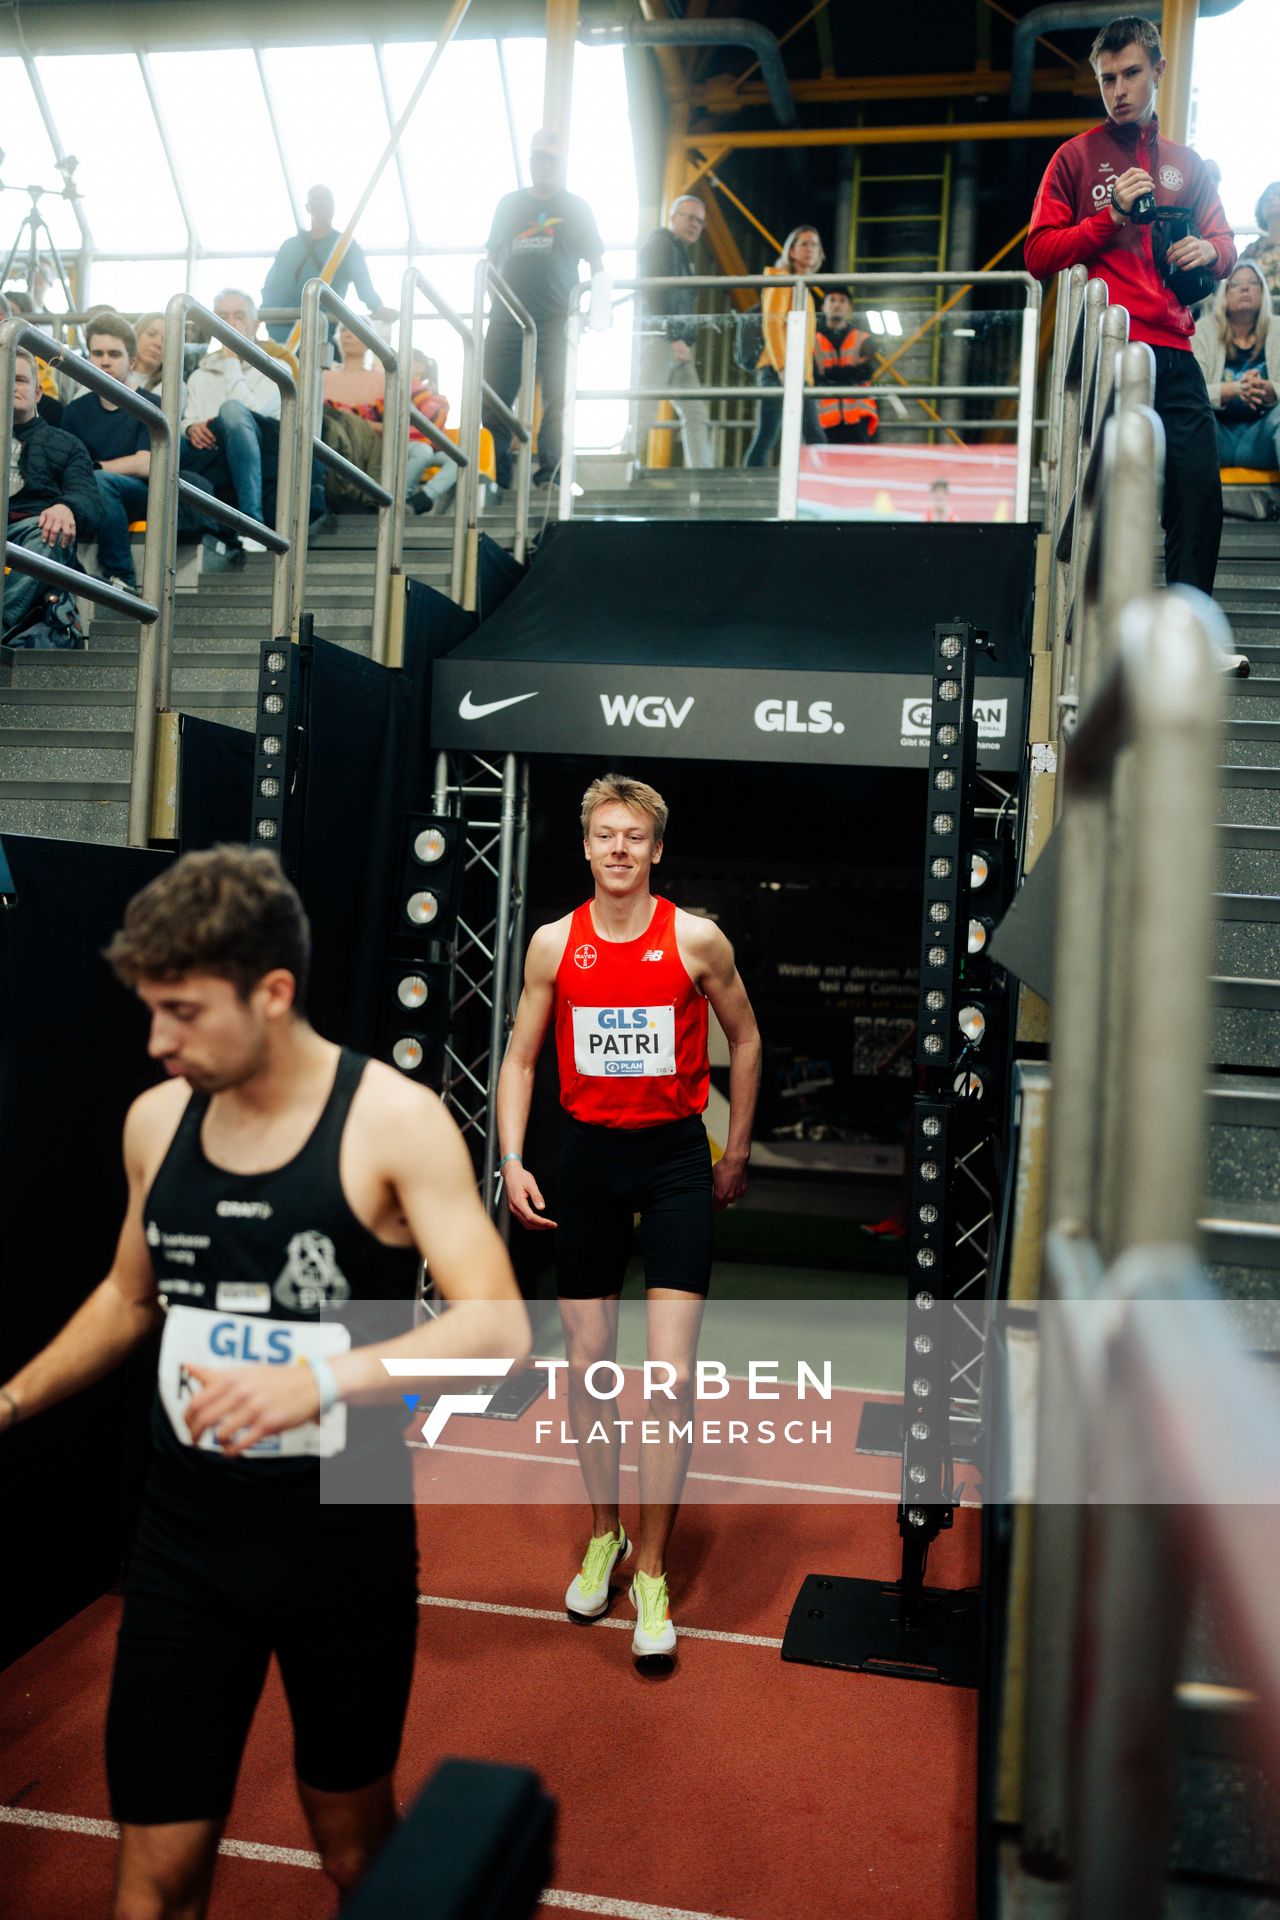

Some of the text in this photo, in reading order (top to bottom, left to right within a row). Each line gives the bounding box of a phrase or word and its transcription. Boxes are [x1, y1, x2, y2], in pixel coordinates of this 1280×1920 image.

[599, 694, 695, 728] WGV
[973, 708, 1001, 722] AN
[824, 966, 846, 977] mit
[844, 982, 865, 993] der
[589, 1034, 659, 1055] PATRI
[620, 1062, 643, 1070] PLAN
